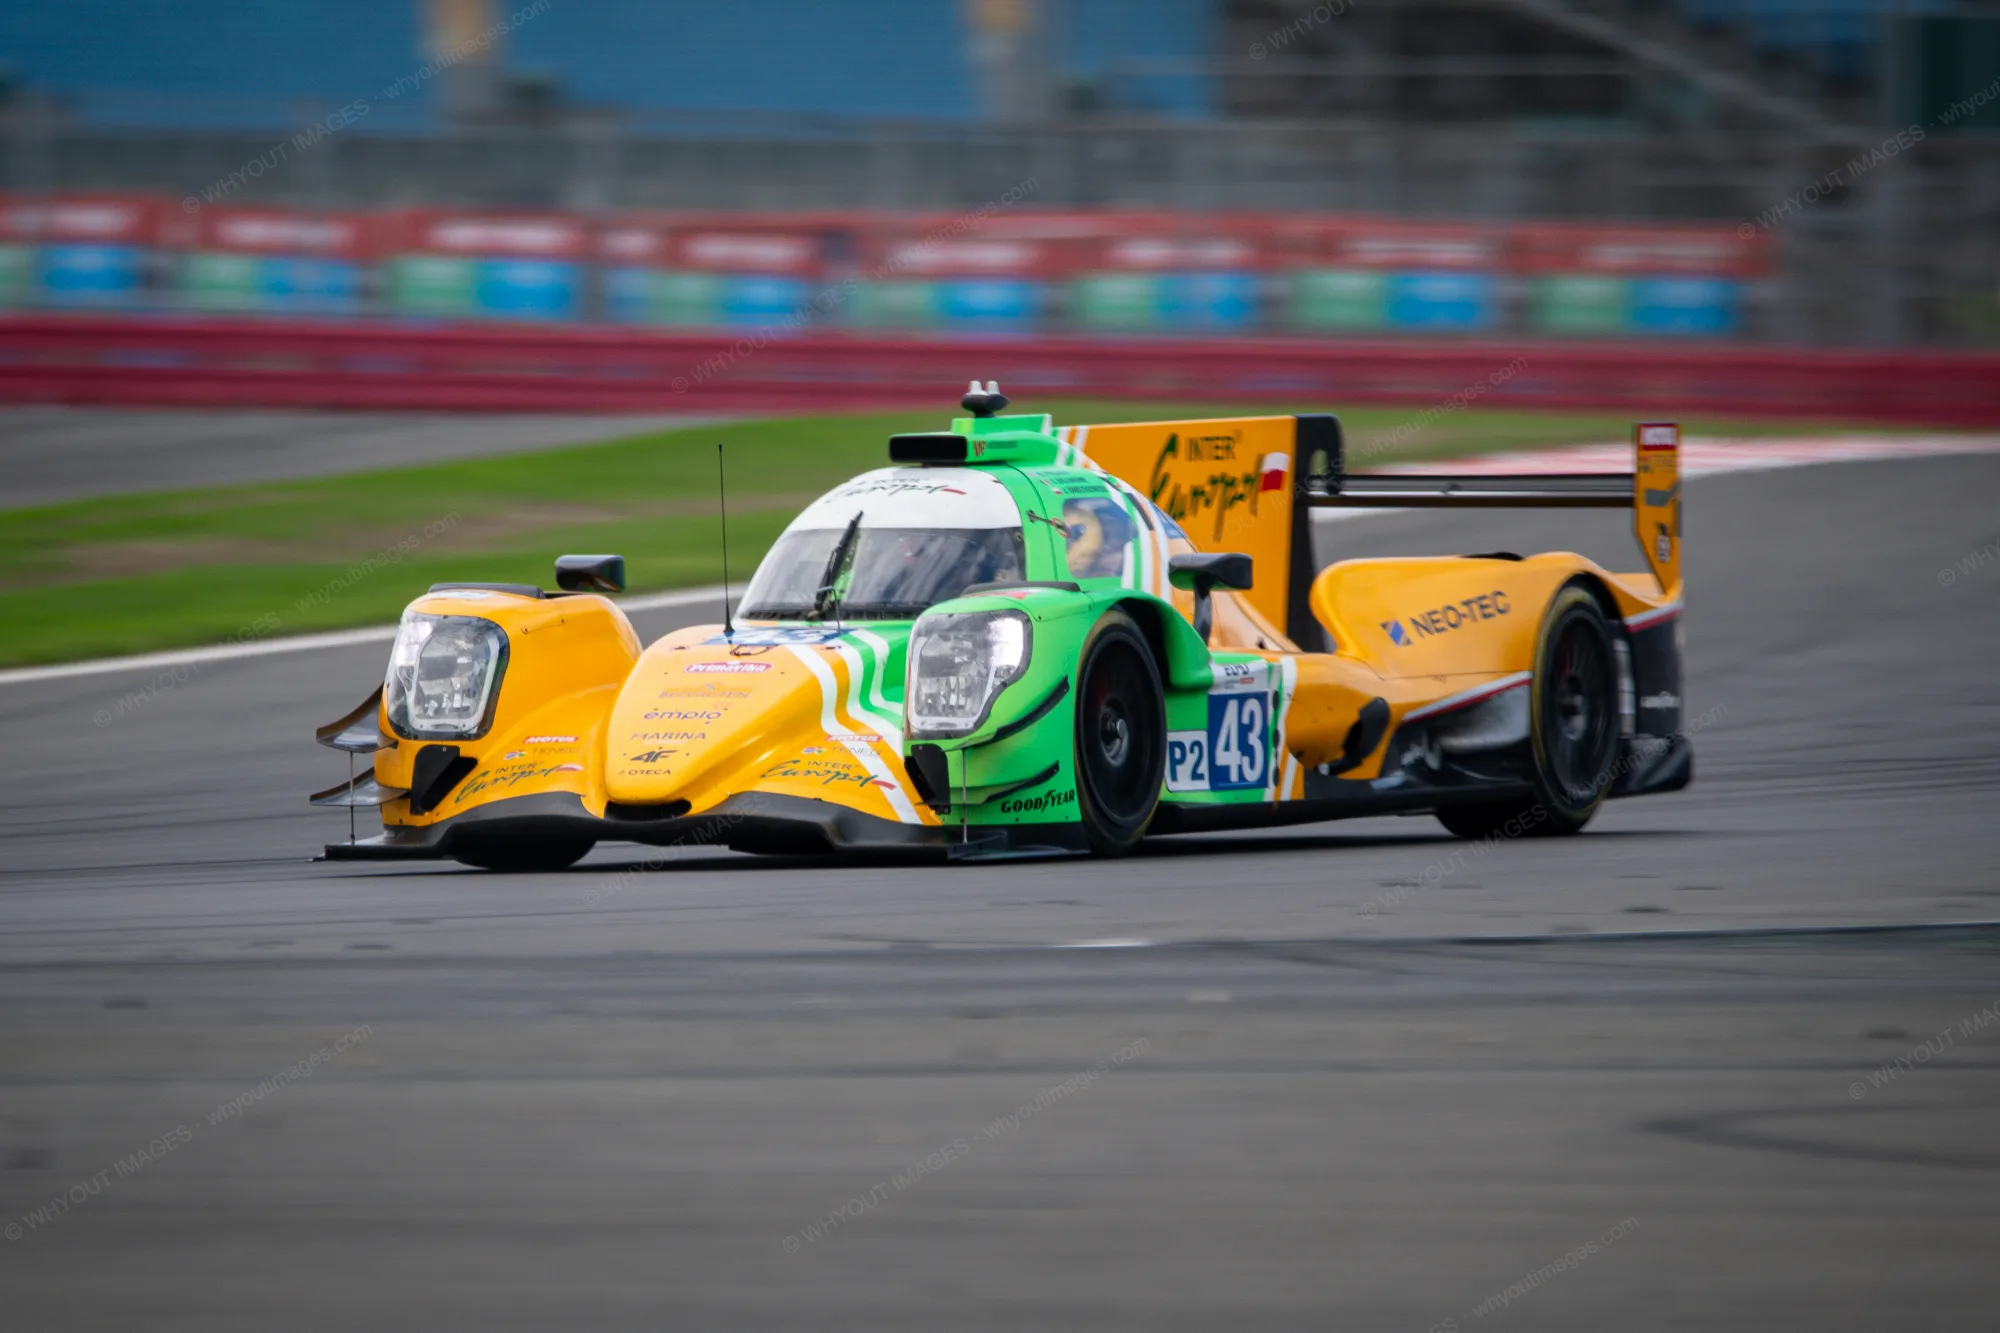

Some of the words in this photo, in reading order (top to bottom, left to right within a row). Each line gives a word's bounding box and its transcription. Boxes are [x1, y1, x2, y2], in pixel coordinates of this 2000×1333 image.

[1186, 436, 1236, 461] INTER
[1409, 590, 1510, 638] NEO-TEC
[631, 732, 707, 740] MARINA
[1215, 698, 1265, 783] 43
[495, 762, 538, 774] INTER
[807, 760, 852, 770] INTER
[1168, 740, 1206, 783] P2
